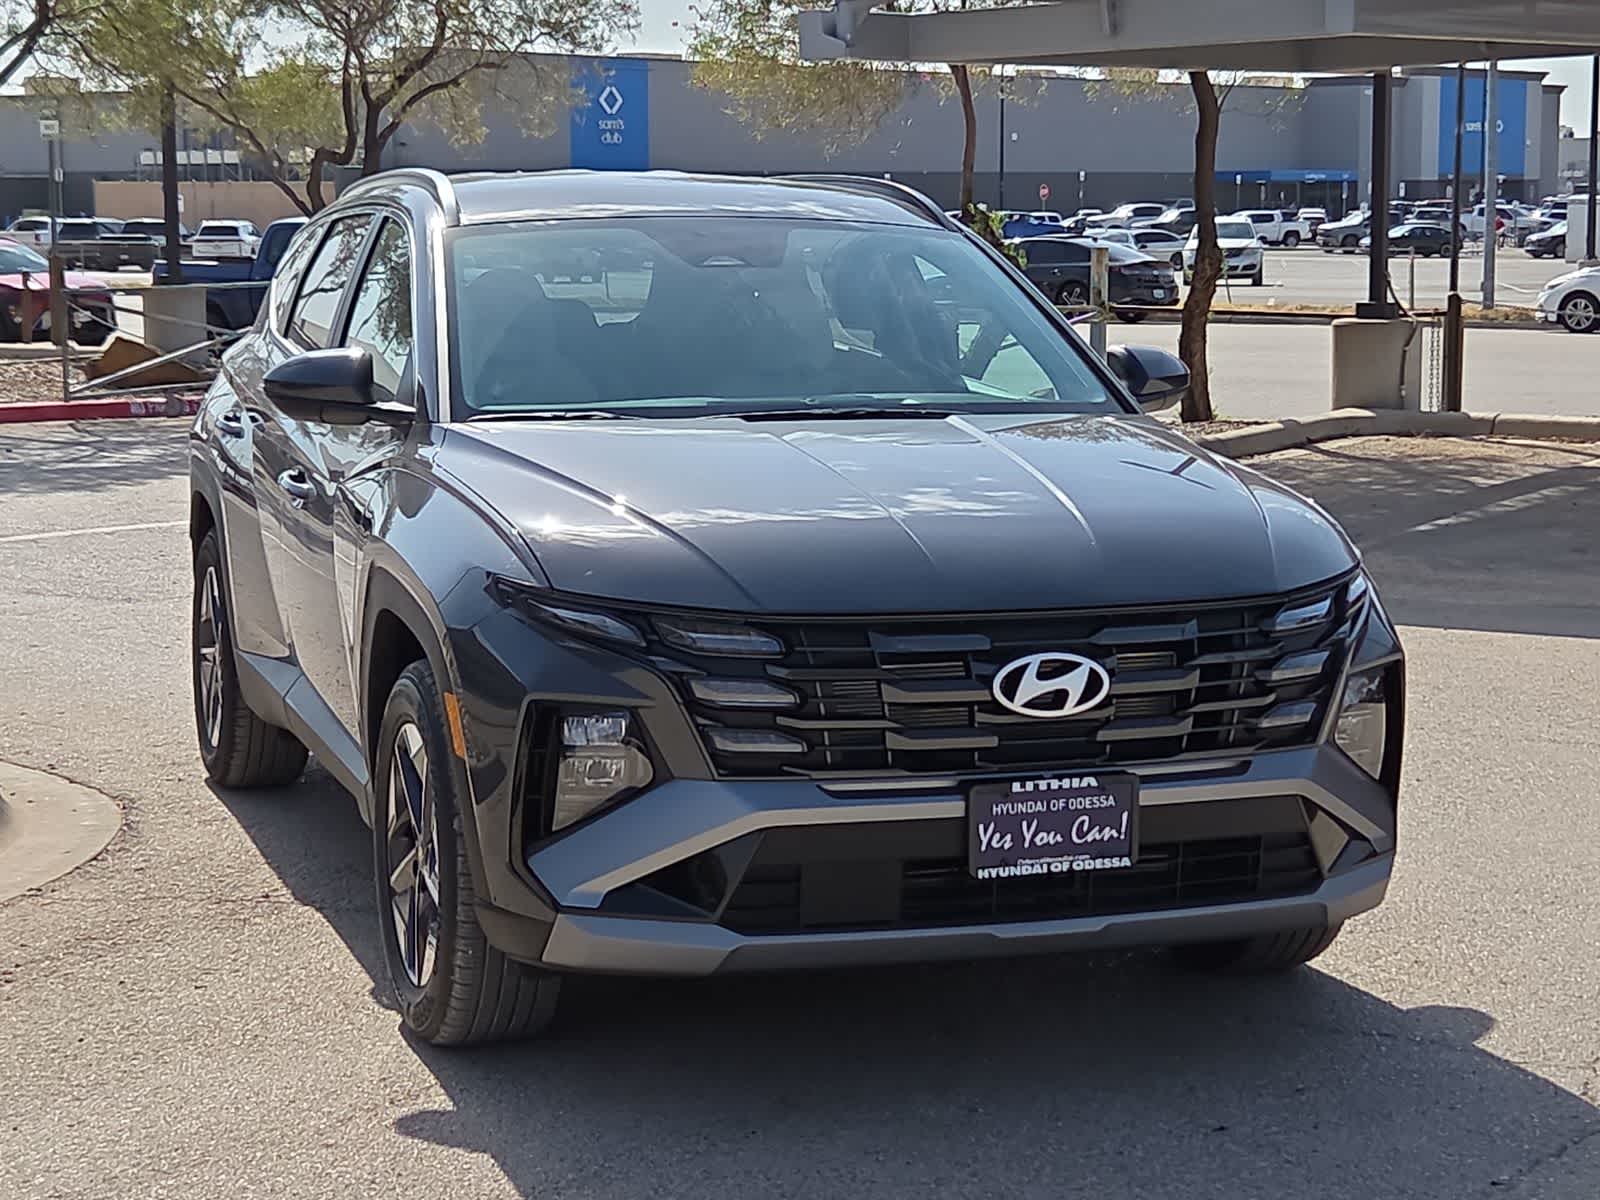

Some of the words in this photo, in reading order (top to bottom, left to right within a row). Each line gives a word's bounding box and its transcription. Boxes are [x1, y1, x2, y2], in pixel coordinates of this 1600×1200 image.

[1011, 776, 1099, 793] LITHIA
[992, 800, 1047, 816] HYUNDAI
[1050, 798, 1067, 812] OF
[1068, 794, 1116, 811] ODESSA
[978, 821, 1014, 852] Yes
[1021, 818, 1064, 849] You
[1071, 810, 1129, 844] Can!
[977, 862, 1048, 880] HYUNDAI
[1050, 860, 1070, 873] OF
[1072, 856, 1132, 871] ODESSA
